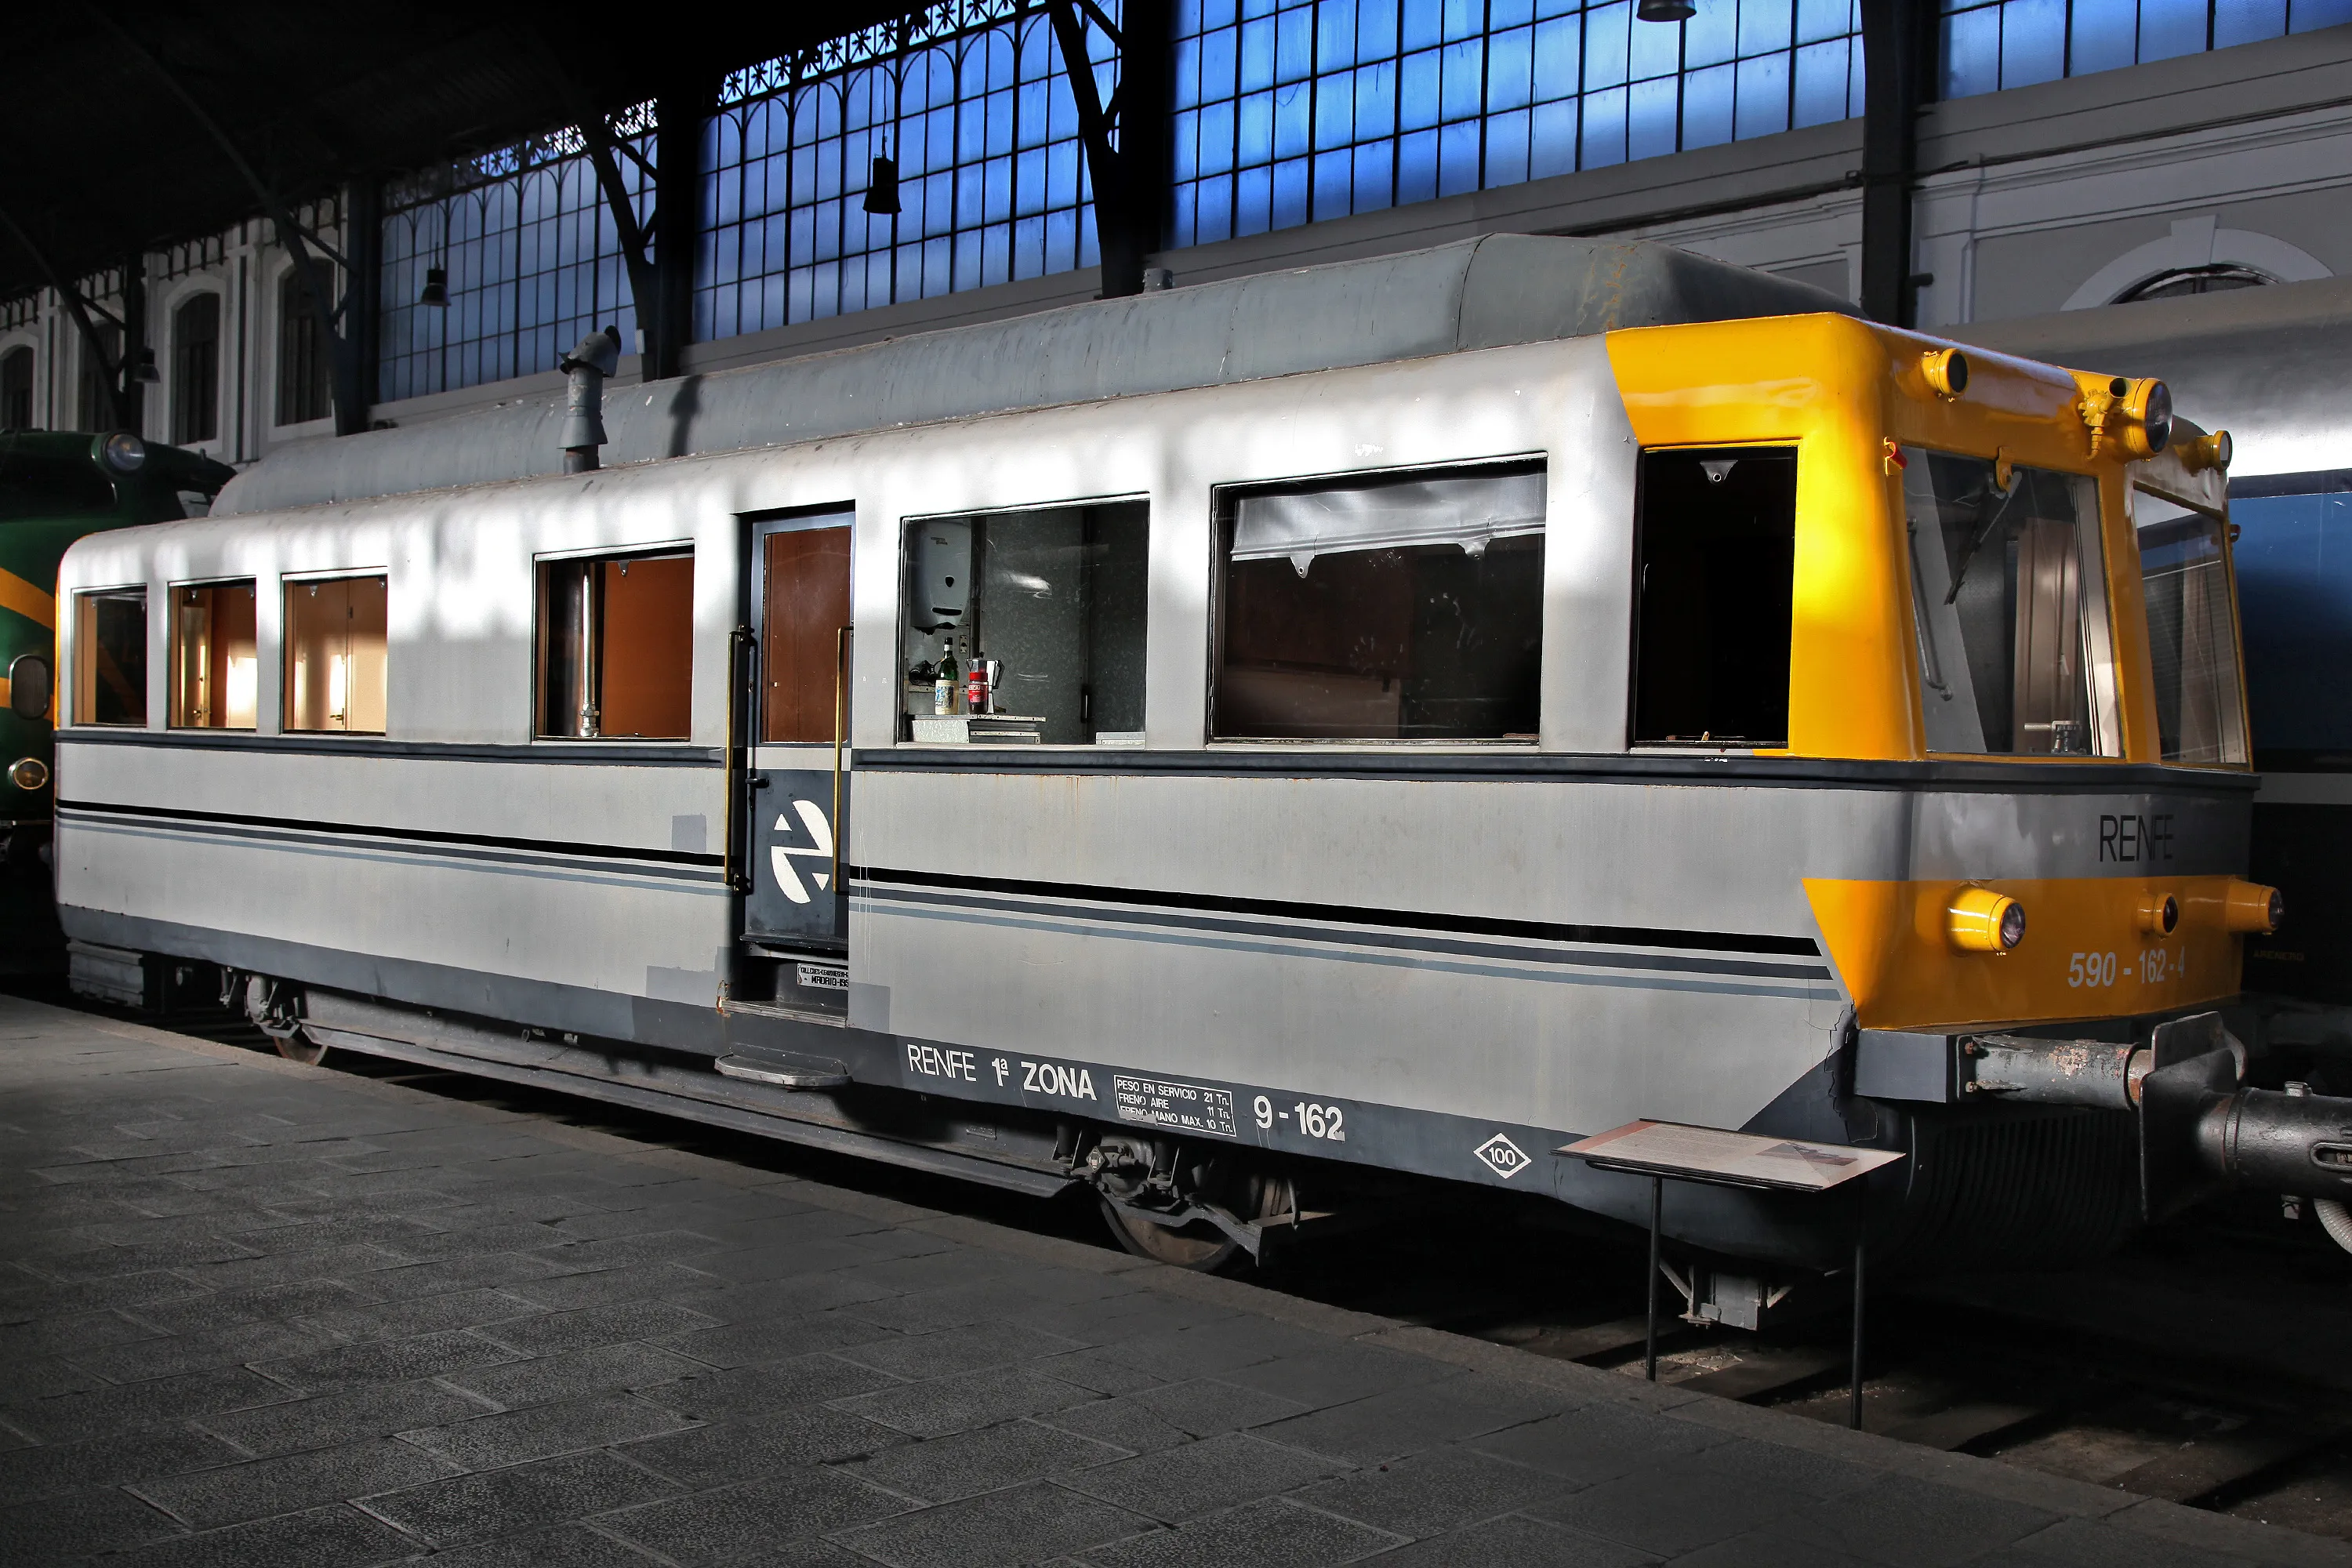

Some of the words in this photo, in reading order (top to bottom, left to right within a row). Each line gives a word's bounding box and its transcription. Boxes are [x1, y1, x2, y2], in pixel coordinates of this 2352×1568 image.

[2100, 814, 2174, 862] RENFE
[907, 1044, 977, 1082] RENFE
[991, 1057, 1010, 1087] 1ª
[1020, 1061, 1098, 1101] ZONA
[1116, 1079, 1139, 1092] PESO
[1142, 1083, 1156, 1094] EN
[1158, 1084, 1197, 1101] SERVICIO
[1203, 1091, 1214, 1103] 21
[1216, 1093, 1229, 1105] Tn.
[1118, 1092, 1146, 1105] FRENO
[1150, 1098, 1170, 1109] AIRE
[1207, 1105, 1214, 1116] 11
[1151, 1109, 1178, 1123] MANO
[1181, 1114, 1204, 1127] MAX.
[1206, 1119, 1216, 1131] 10
[1219, 1120, 1233, 1133] Tn.
[1488, 1146, 1516, 1166] 100
